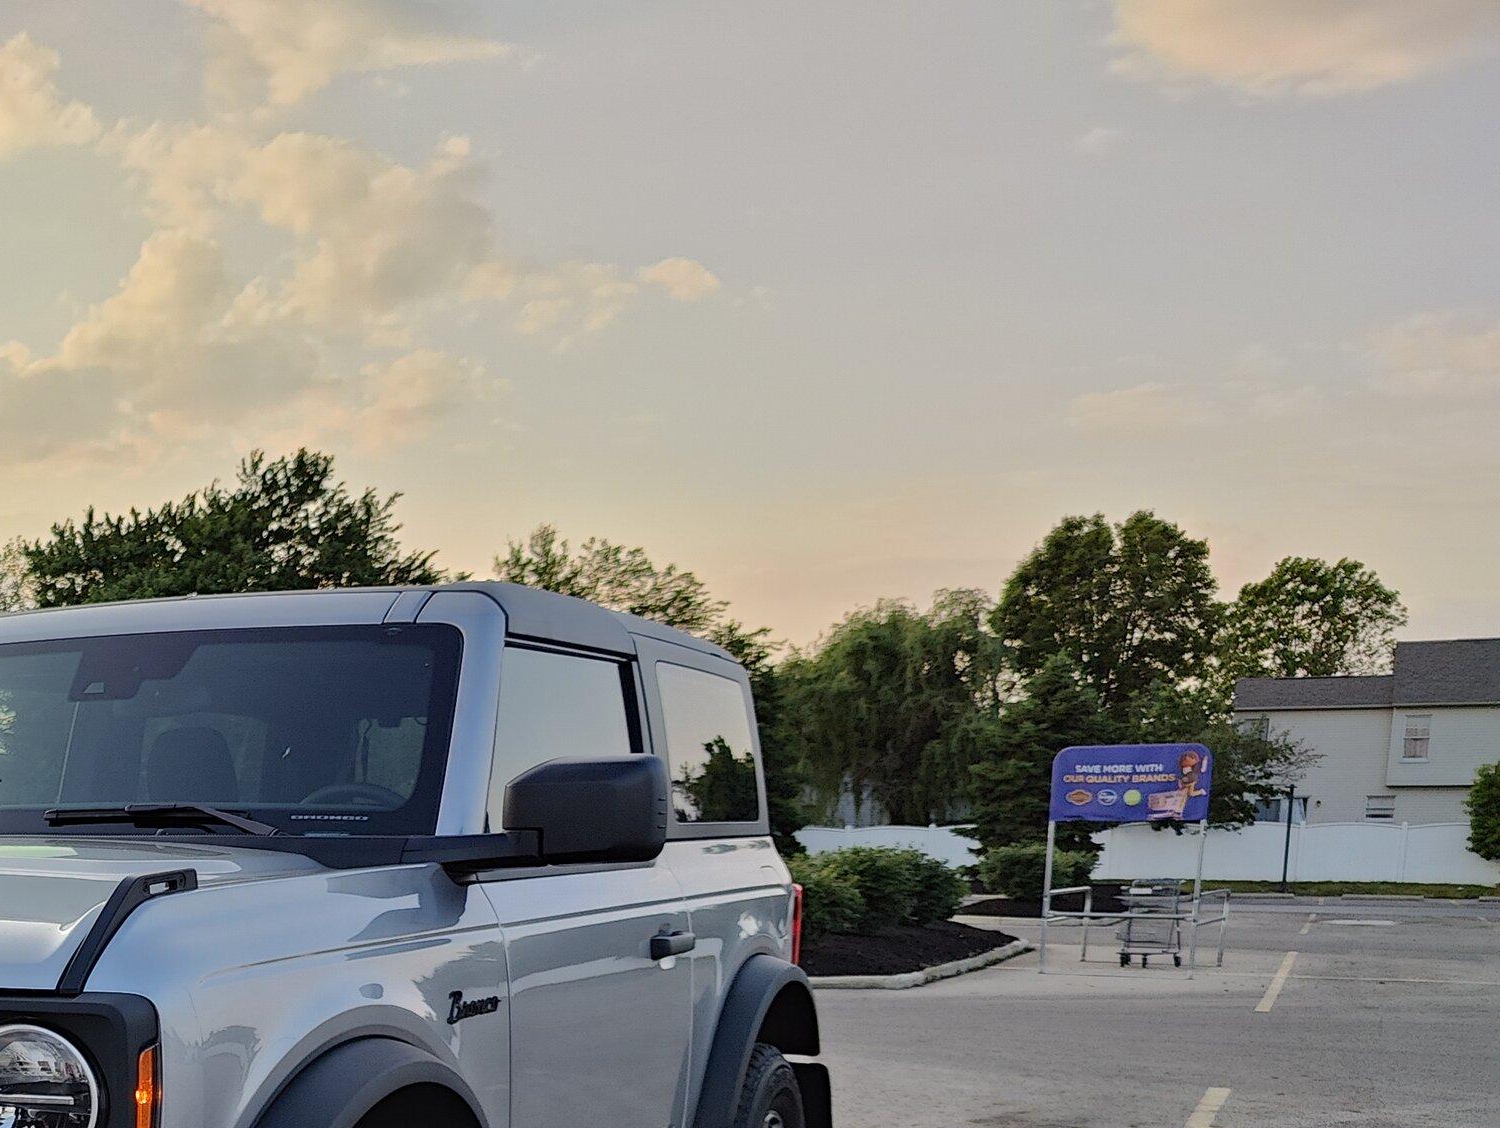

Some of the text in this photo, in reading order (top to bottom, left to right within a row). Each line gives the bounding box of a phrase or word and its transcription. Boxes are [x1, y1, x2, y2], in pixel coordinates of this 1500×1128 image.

[1075, 763, 1164, 773] SAVE MORE WITH
[1063, 773, 1176, 784] OUR QUALITY BRANDS
[446, 990, 501, 1025] Bronco
